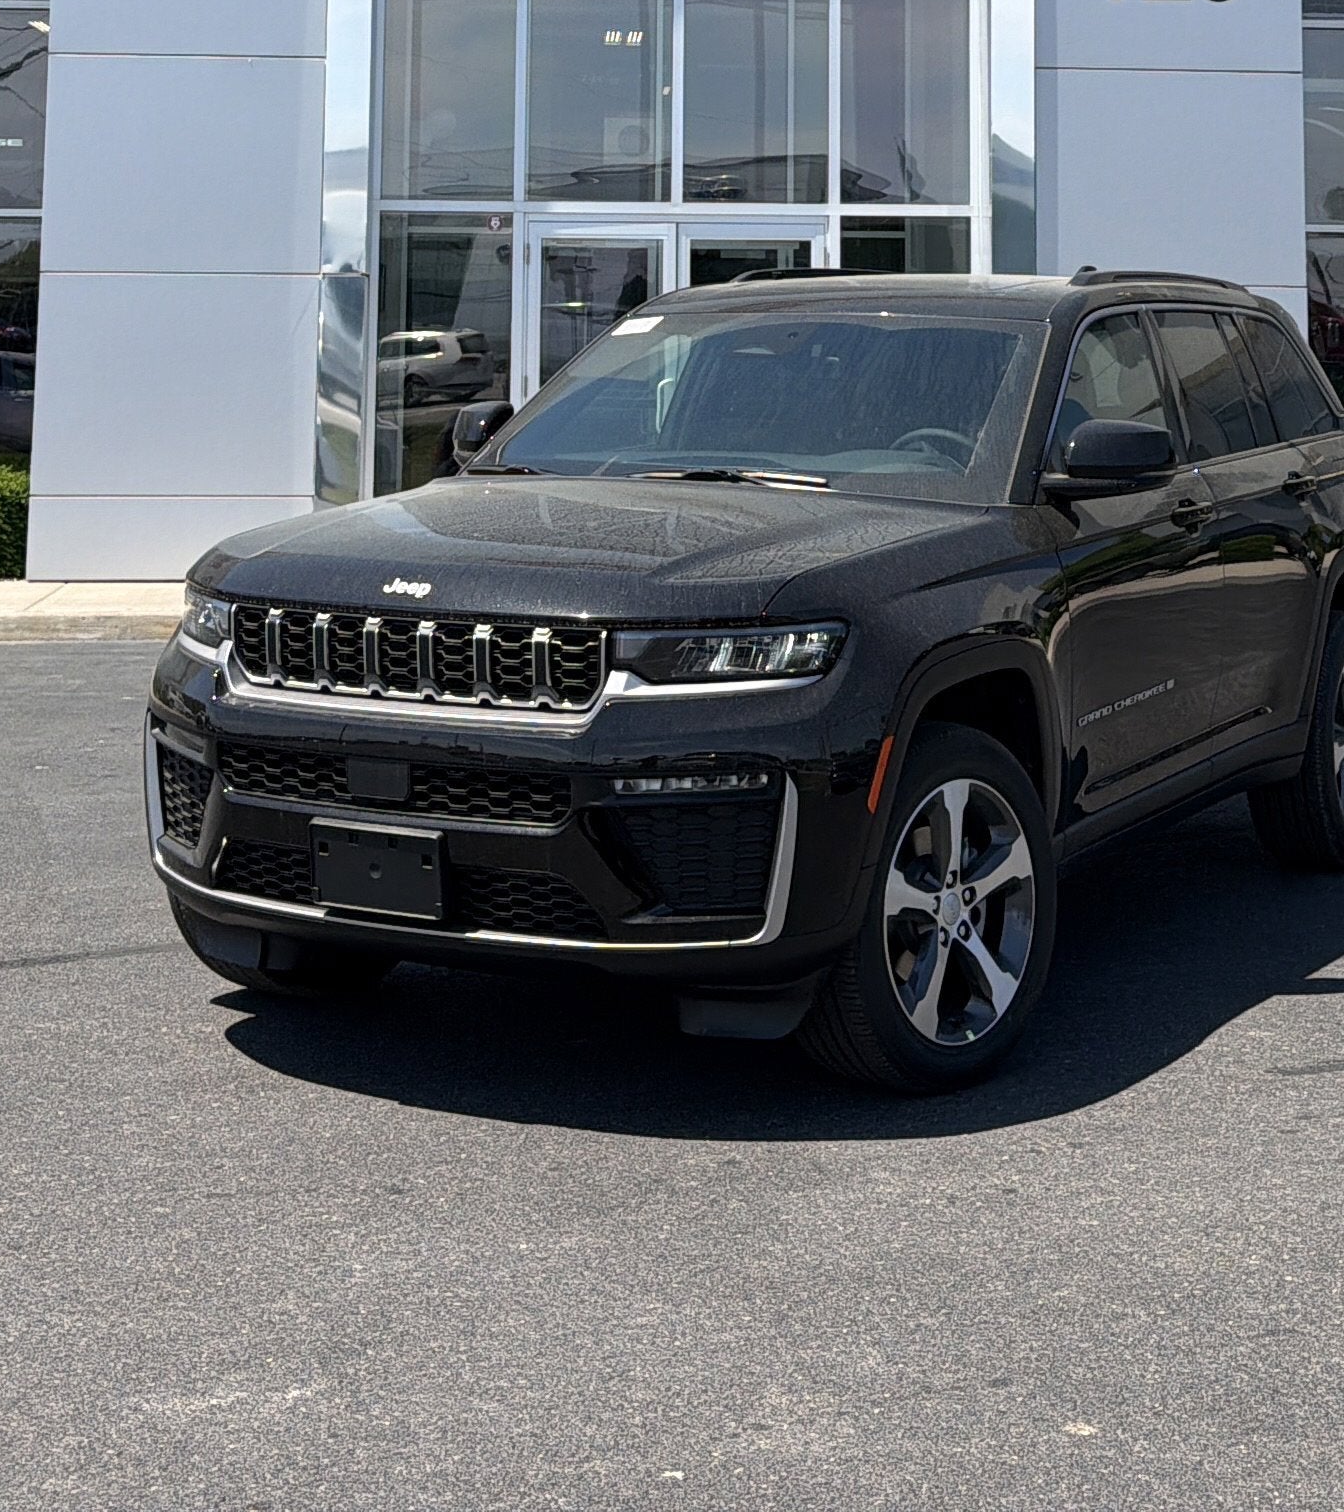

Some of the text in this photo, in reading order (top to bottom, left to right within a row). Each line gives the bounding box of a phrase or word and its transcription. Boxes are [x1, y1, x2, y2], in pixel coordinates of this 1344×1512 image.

[383, 577, 432, 598] Jeep
[1078, 682, 1166, 727] GRAND CHEROKEE
